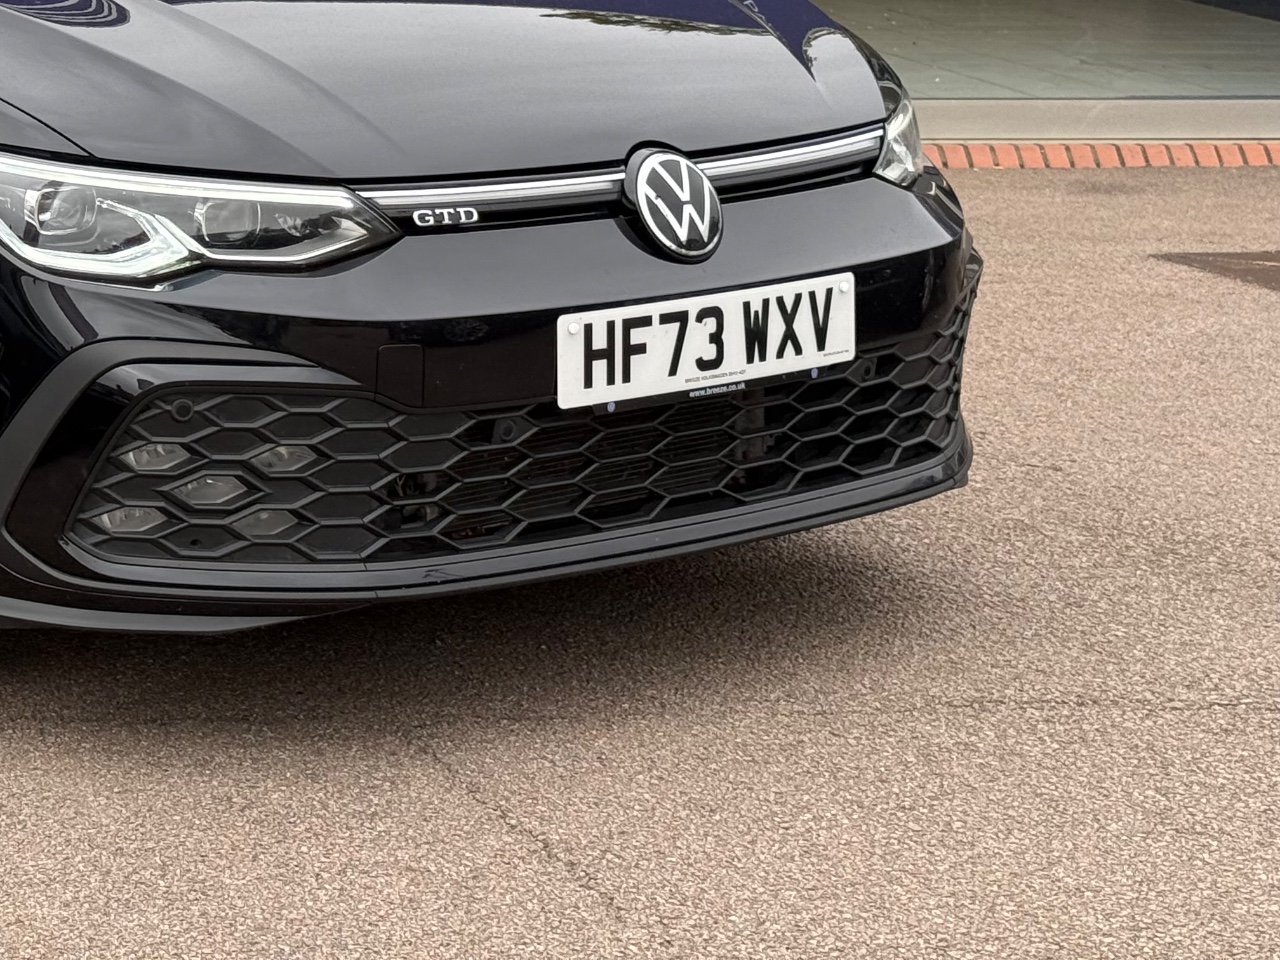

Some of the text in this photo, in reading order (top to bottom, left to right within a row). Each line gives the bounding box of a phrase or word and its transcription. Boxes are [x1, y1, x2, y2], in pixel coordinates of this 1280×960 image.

[411, 206, 480, 228] GTD
[583, 286, 834, 390] HF73 WXV
